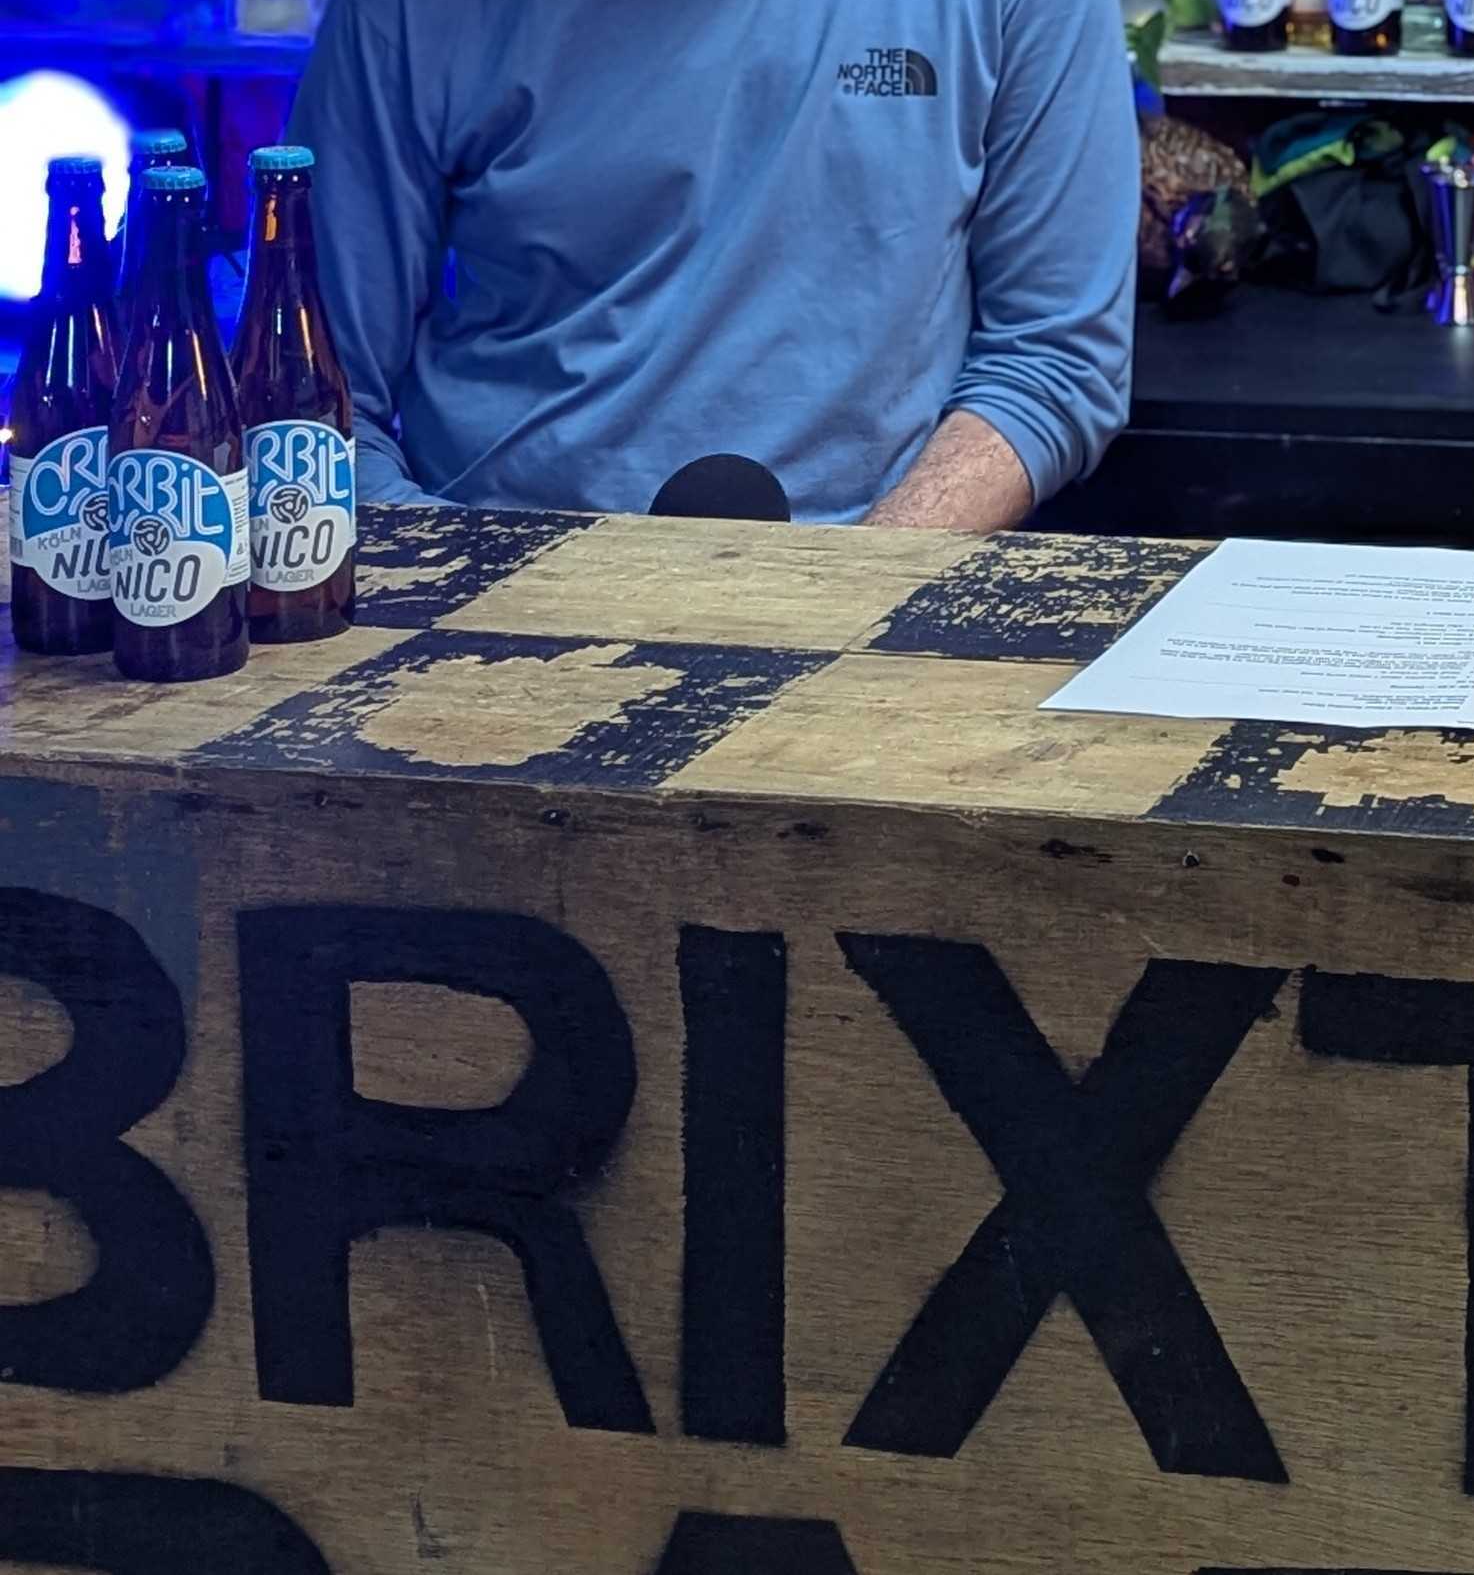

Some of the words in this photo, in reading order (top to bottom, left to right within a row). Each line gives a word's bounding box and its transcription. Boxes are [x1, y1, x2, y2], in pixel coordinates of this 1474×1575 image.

[865, 48, 903, 64] THE
[837, 63, 903, 80] NORTH
[854, 81, 903, 97] FACE
[37, 528, 82, 550] KÖLN
[250, 519, 335, 569] NICO
[52, 534, 110, 579] NIC
[115, 555, 201, 603] NICO
[266, 569, 314, 584] LAGER
[77, 579, 111, 593] LAG
[130, 604, 176, 618] LAGER
